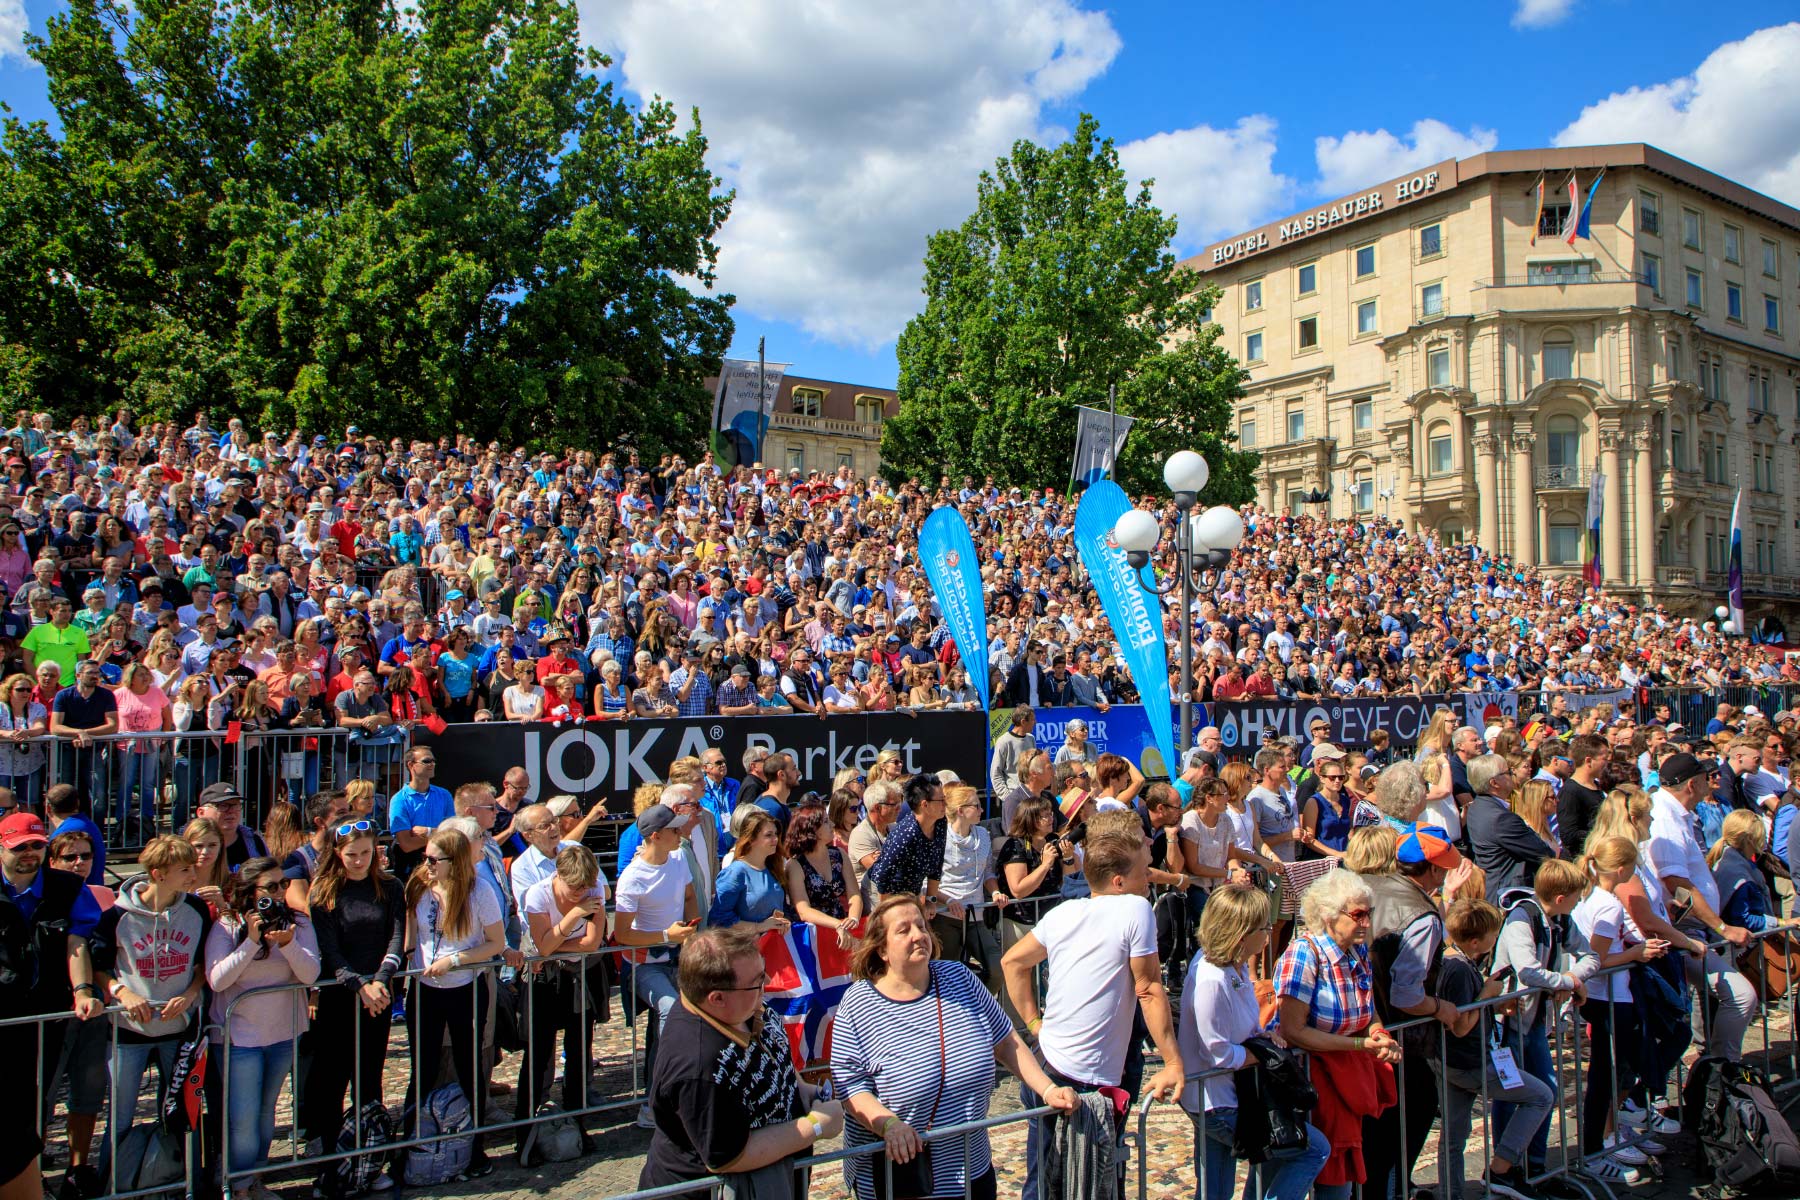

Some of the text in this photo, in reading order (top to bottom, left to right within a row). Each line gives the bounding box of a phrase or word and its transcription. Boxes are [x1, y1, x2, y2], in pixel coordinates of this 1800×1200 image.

[1212, 171, 1439, 263] HOTEL NASSAUER HOF
[1034, 720, 1109, 743] RDIER
